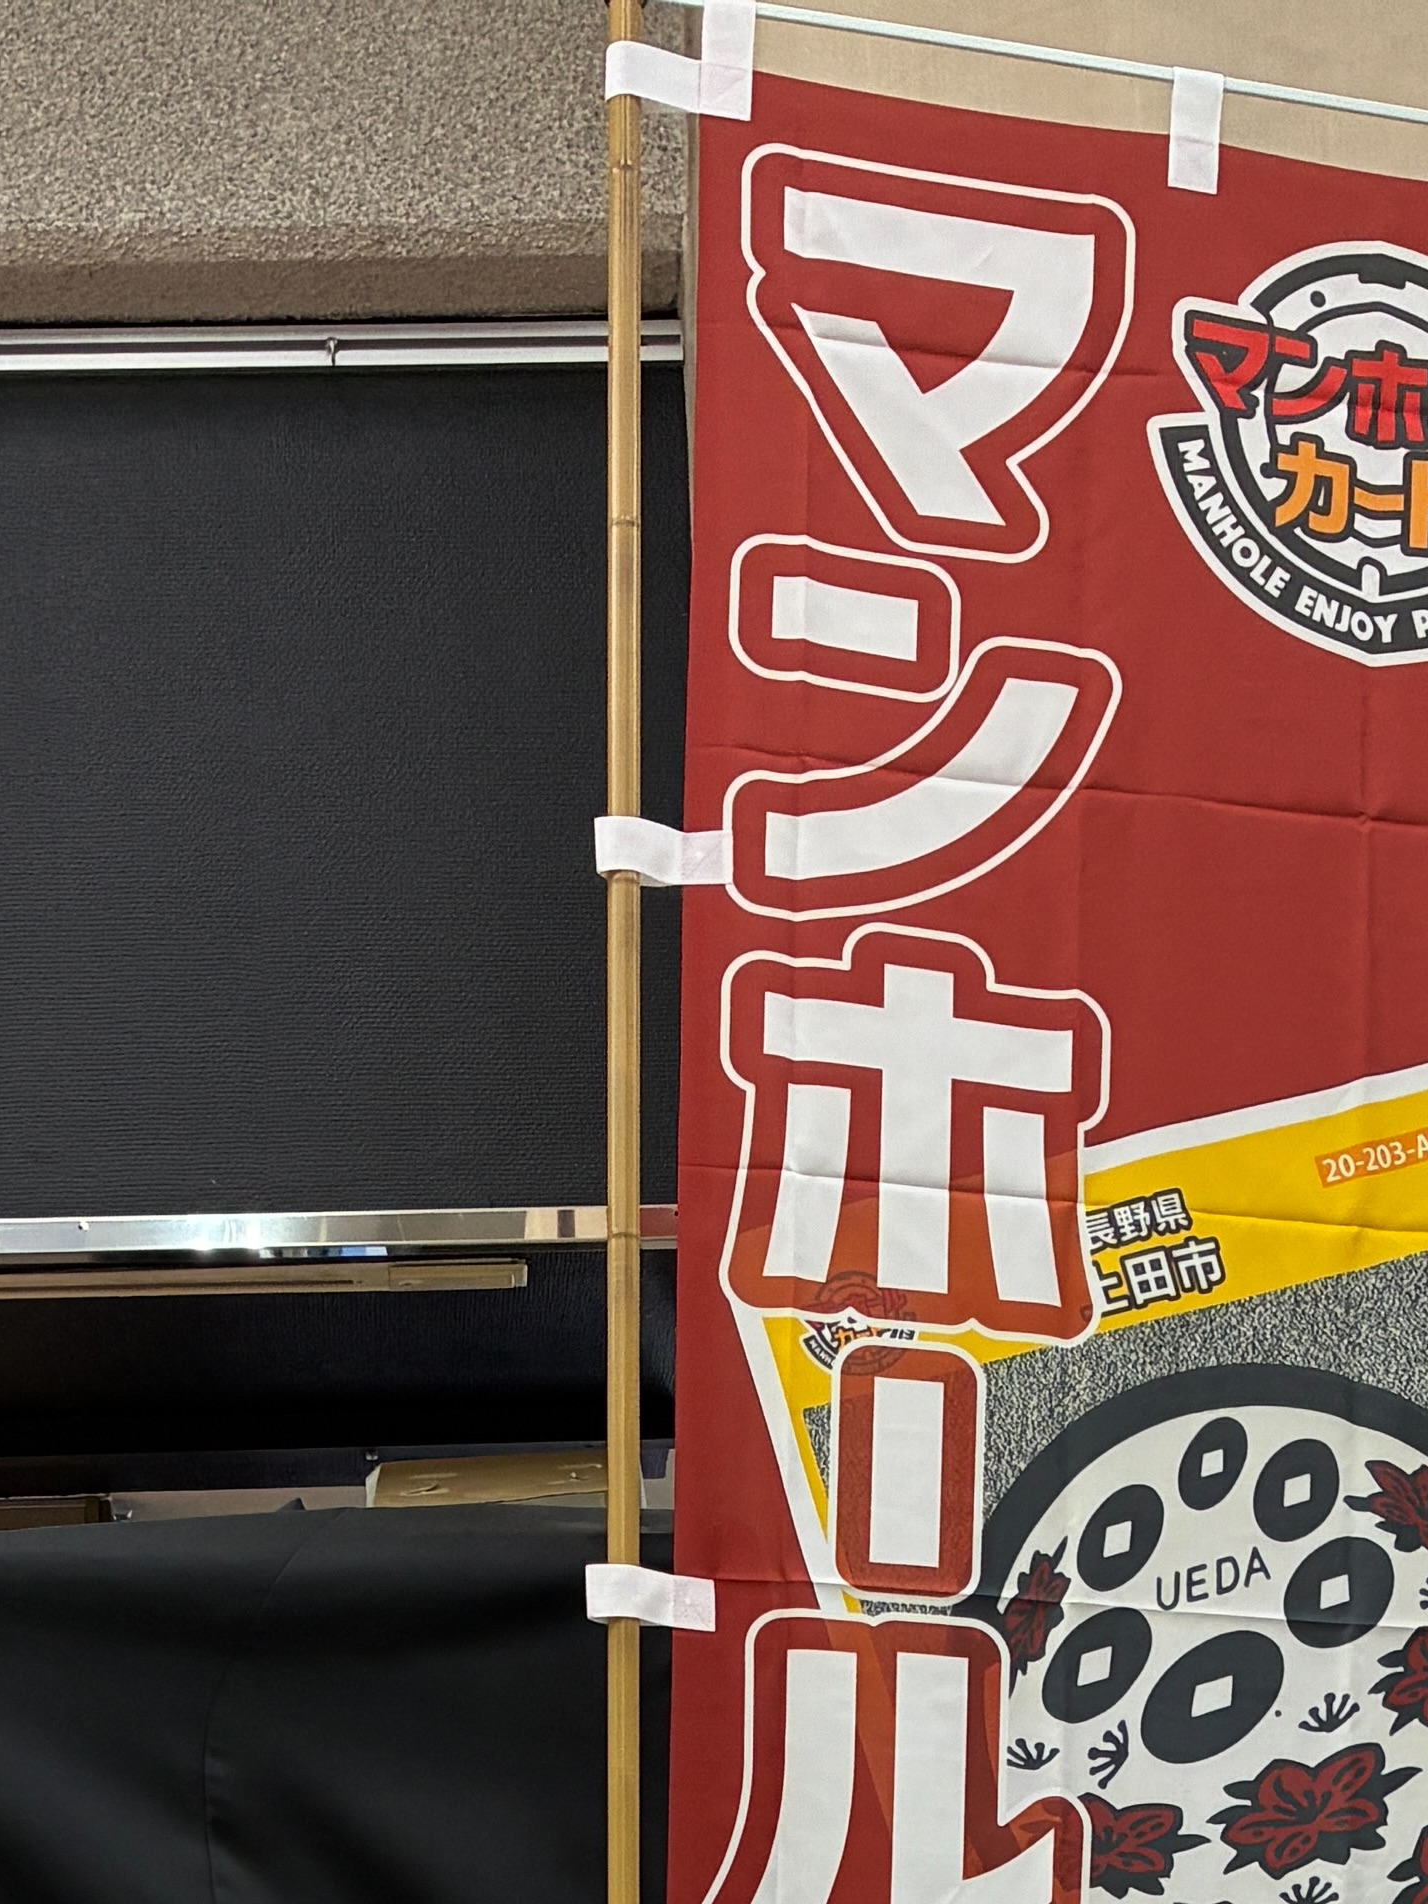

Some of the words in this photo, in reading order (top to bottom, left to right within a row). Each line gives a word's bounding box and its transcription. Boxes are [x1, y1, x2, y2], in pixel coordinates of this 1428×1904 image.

[1177, 438, 1292, 599] MANHOLE
[1293, 588, 1399, 645] ENJOY
[1084, 1191, 1191, 1249] 長野県
[1096, 1239, 1223, 1312] 上田市
[1155, 1545, 1274, 1612] UEDA
